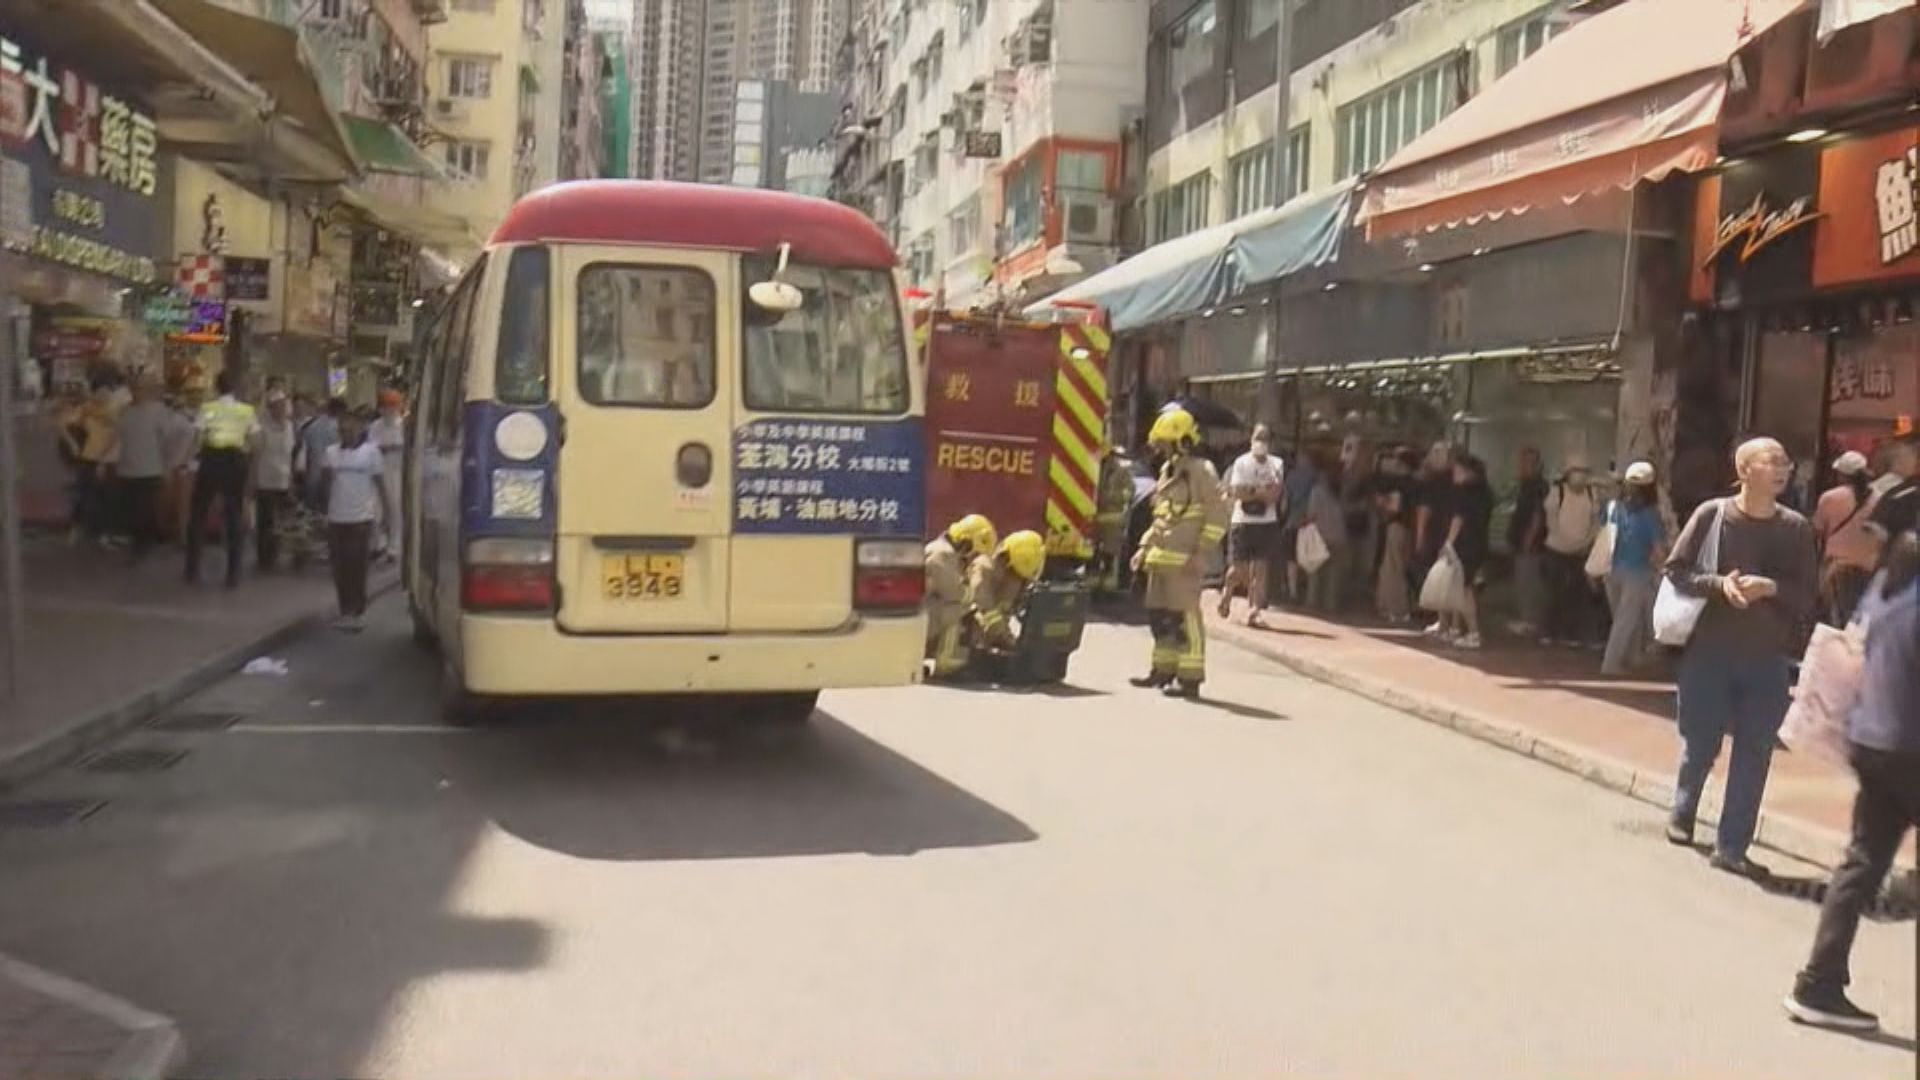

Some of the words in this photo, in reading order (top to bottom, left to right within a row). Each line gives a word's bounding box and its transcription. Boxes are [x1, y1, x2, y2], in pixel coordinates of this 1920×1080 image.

[737, 443, 841, 470] 荃灣分校
[937, 443, 1035, 475] RESCUE
